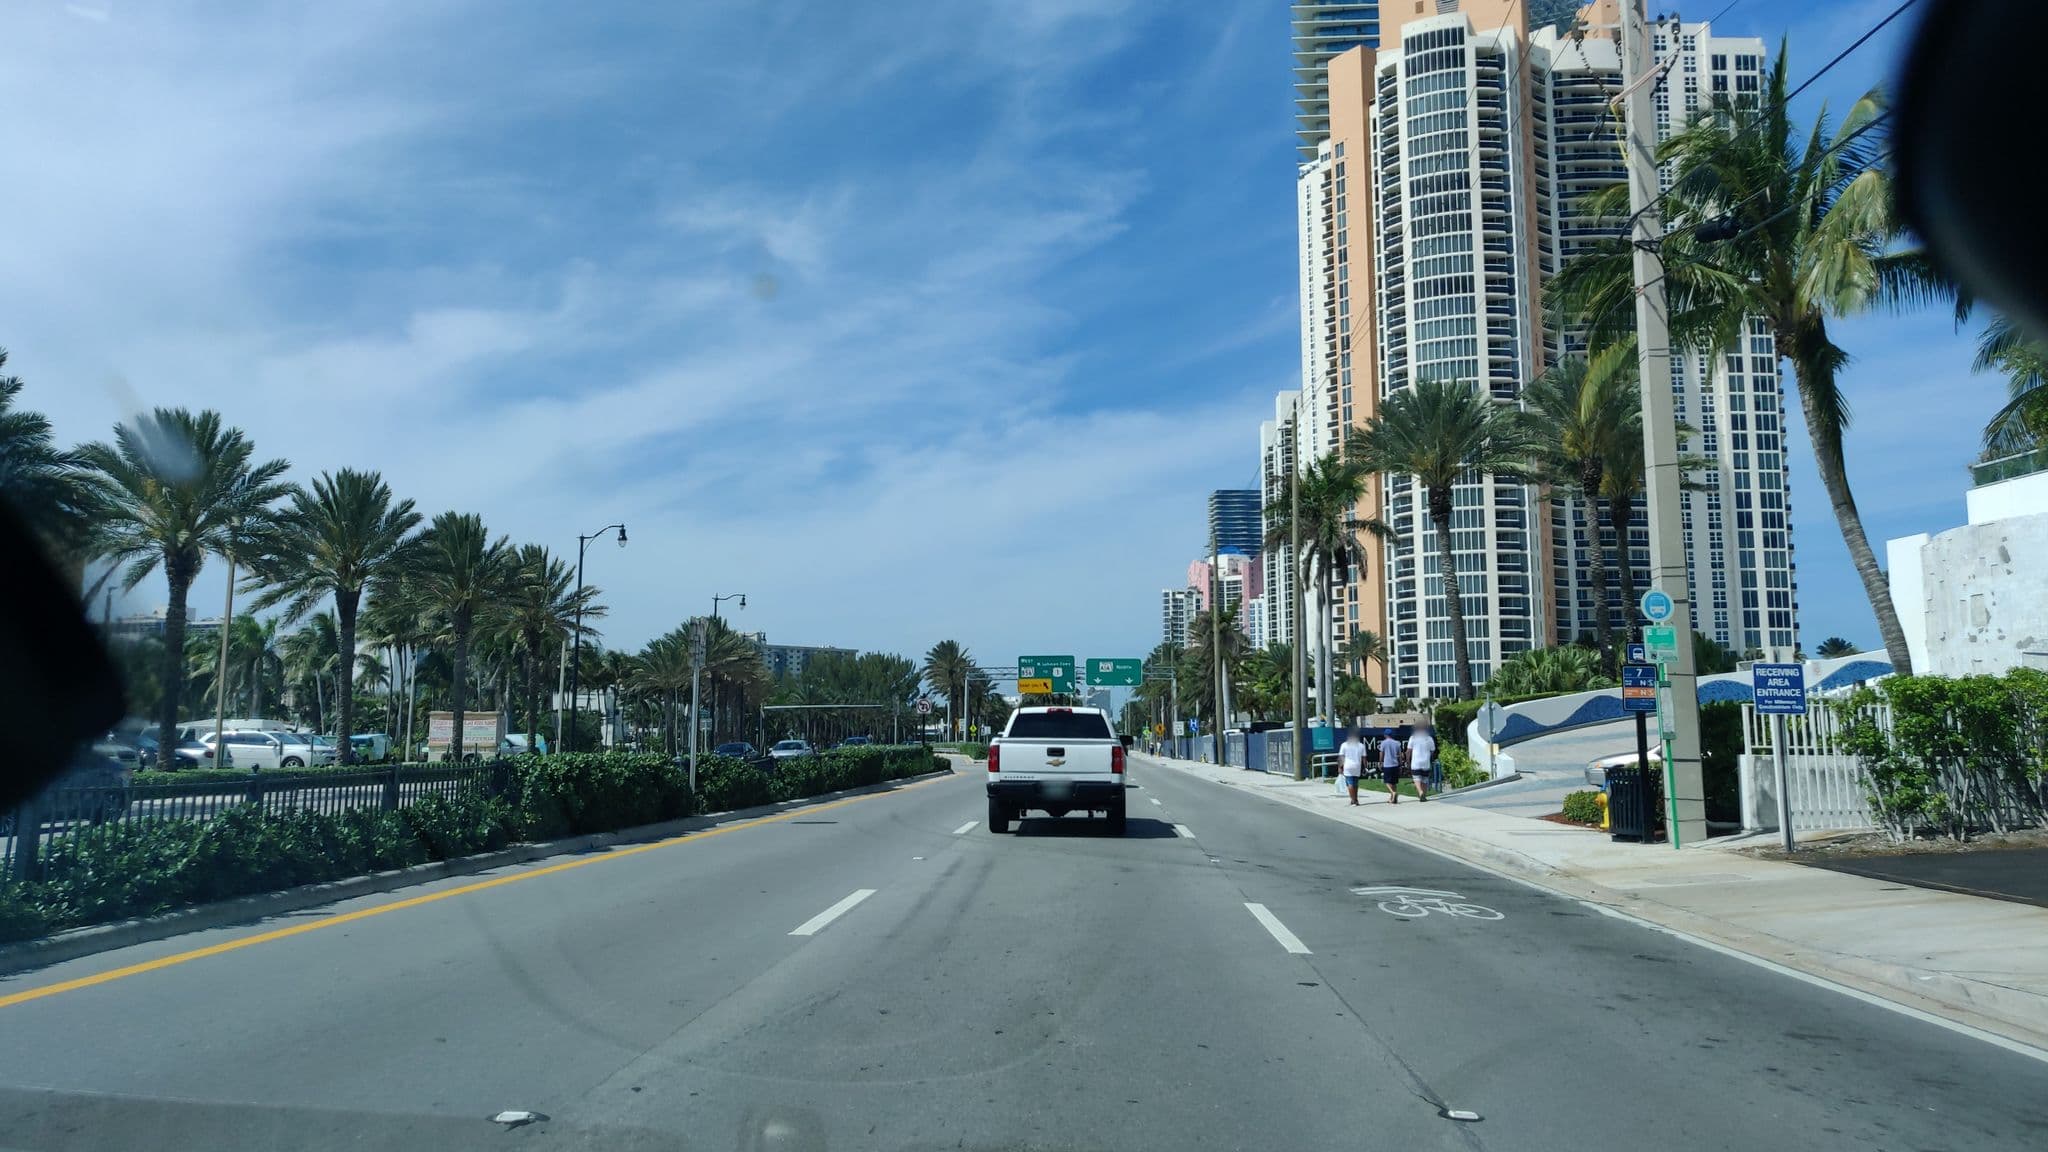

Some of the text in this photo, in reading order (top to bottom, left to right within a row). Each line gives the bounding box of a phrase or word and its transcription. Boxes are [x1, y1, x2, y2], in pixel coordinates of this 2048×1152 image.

[1636, 668, 1643, 677] 7
[1755, 668, 1799, 677] RECEIVING
[1767, 678, 1790, 686] AREA
[1756, 688, 1801, 697] ENTRANCE
